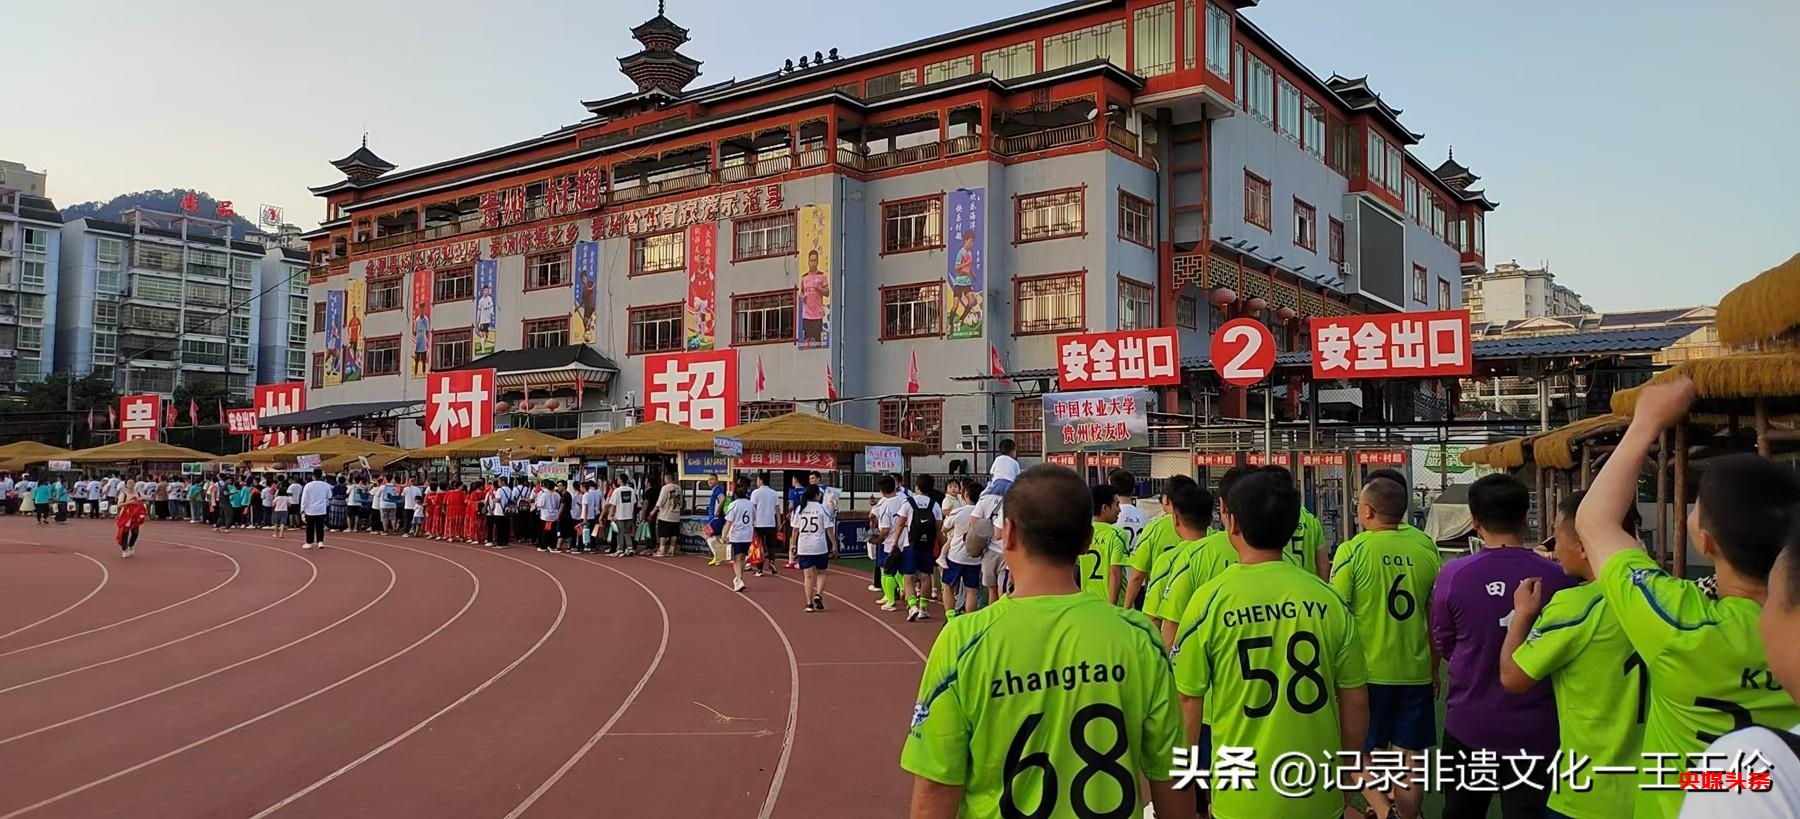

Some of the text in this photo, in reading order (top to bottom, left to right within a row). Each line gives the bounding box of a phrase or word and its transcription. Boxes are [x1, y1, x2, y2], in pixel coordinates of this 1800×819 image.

[545, 166, 600, 217] 村超
[1062, 336, 1175, 382] 安全出口
[1222, 325, 1265, 379] 2
[1318, 318, 1464, 371] 安全出口
[228, 411, 257, 431] 安全出口
[430, 374, 488, 445] 村
[651, 359, 726, 432] 超
[1054, 395, 1136, 419] 中国农业大学
[1062, 422, 1132, 444] 贵州校友队
[742, 510, 750, 524] 6
[800, 516, 819, 533] 25
[1223, 600, 1328, 628] CHENG YY
[1387, 573, 1416, 621] 6
[991, 661, 1125, 699] zhangtao
[1237, 630, 1328, 719] 58
[1000, 703, 1137, 819] 68
